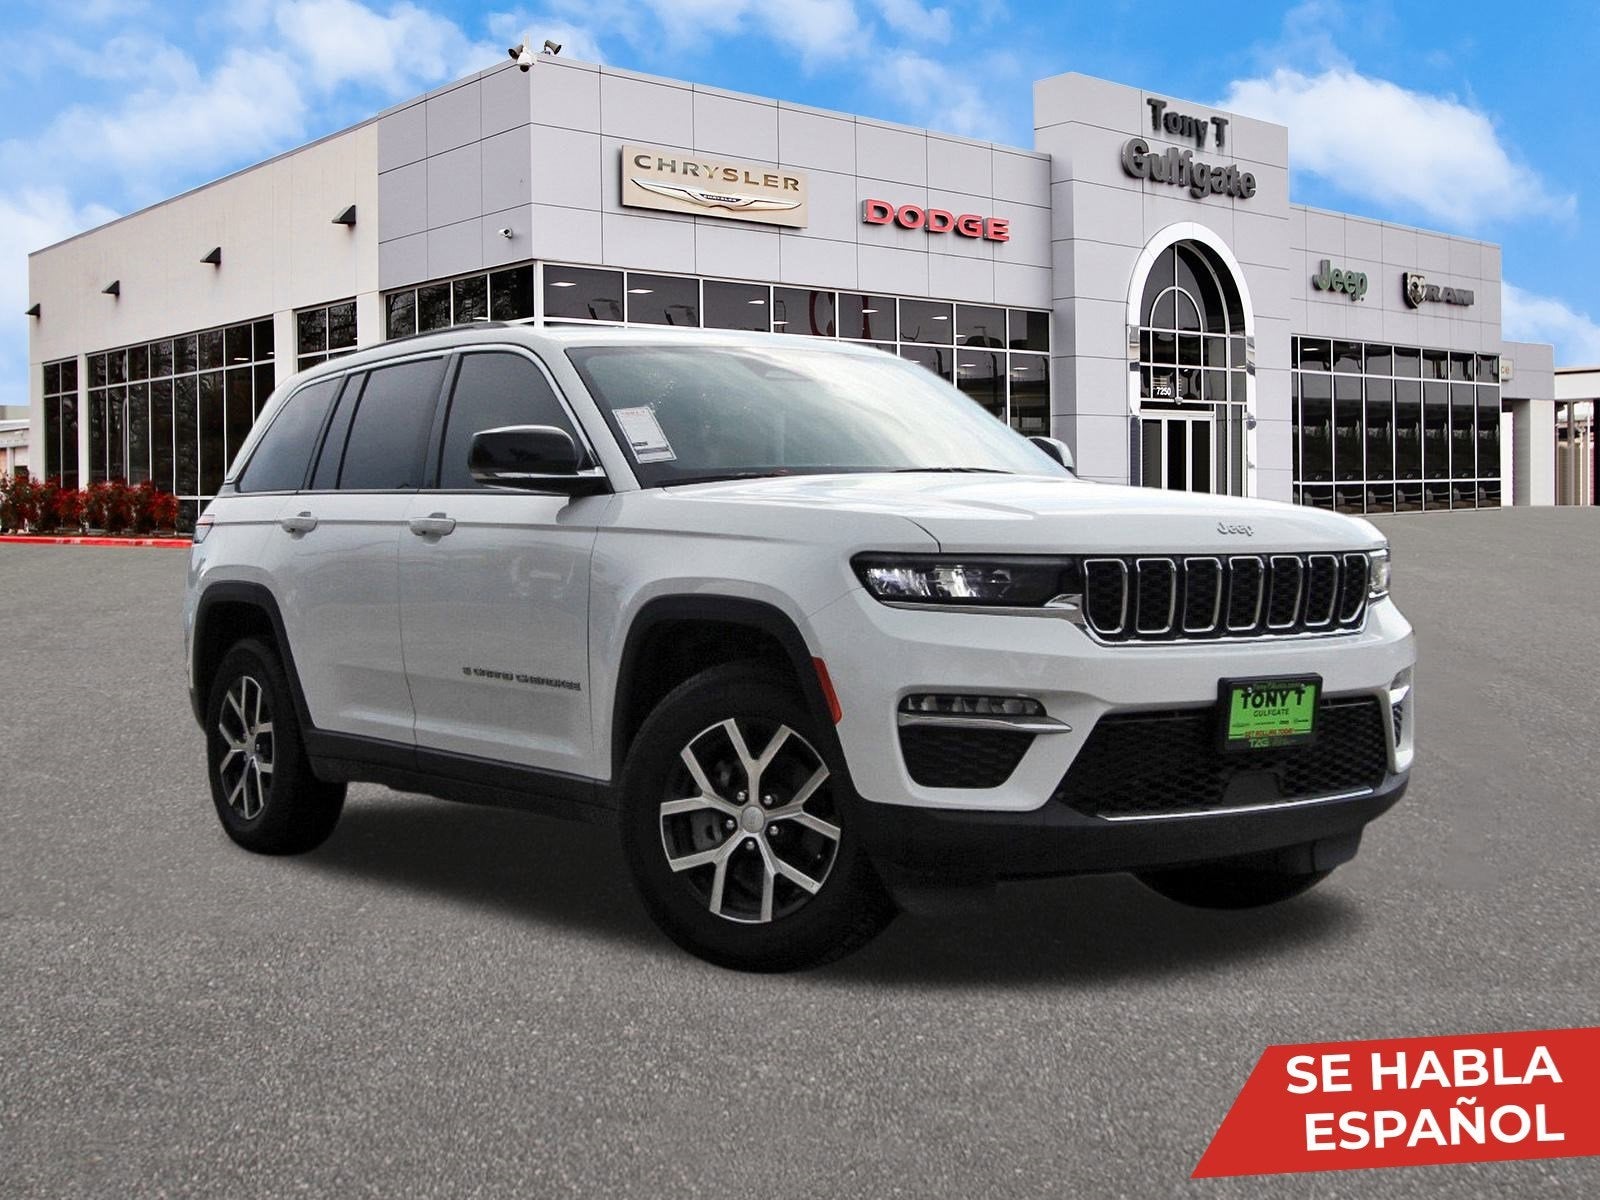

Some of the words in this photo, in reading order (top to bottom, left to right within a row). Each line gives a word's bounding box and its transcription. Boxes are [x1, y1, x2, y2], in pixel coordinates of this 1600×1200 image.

[1147, 98, 1208, 148] Tony
[1211, 116, 1229, 148] T
[634, 154, 800, 191] CHRYSLER
[1121, 138, 1257, 199] Gulfgate
[863, 199, 1010, 242] DODGE
[1312, 259, 1368, 302] Jeep
[1425, 283, 1474, 307] RAM
[1156, 386, 1172, 396] 7250
[1217, 521, 1254, 537] Jeep
[1241, 689, 1291, 709] TONY
[1295, 688, 1306, 706] T
